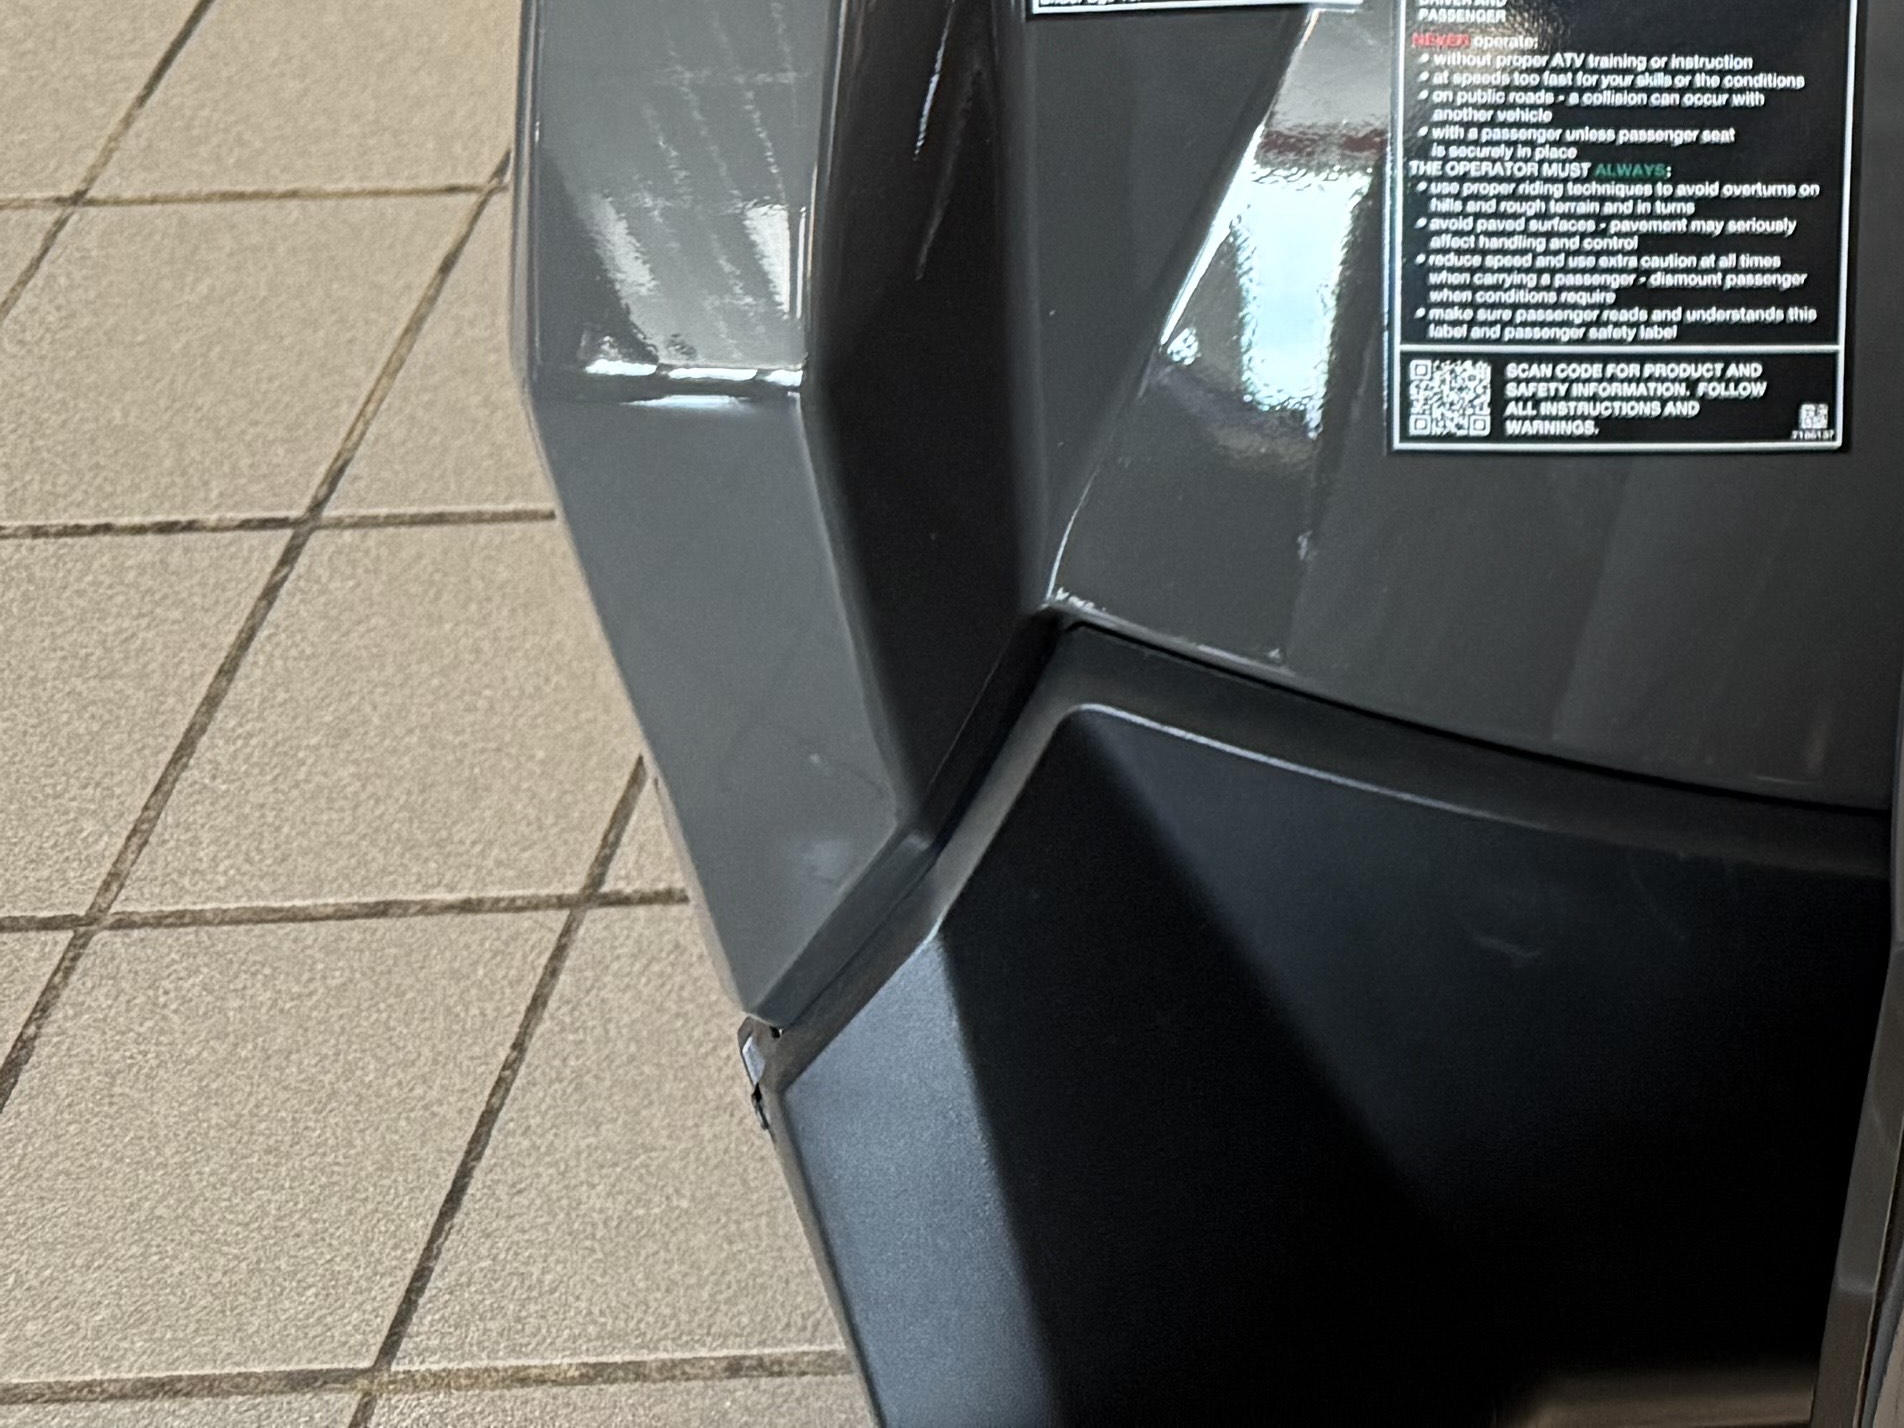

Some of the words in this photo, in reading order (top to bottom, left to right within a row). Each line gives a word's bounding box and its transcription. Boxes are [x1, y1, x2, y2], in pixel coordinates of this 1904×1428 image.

[1505, 362, 1552, 378] SCAN
[1554, 362, 1602, 379] CODE
[1604, 362, 1640, 378] FOR
[1642, 362, 1723, 378] PRODUCT
[1725, 362, 1762, 377] AND
[1505, 381, 1569, 397] SAFETY
[1570, 381, 1690, 397] INFORMATION.
[1696, 381, 1766, 397] FOLLOW
[1504, 400, 1537, 416] ALL
[1539, 400, 1661, 416] INSTRUCTIONS
[1663, 400, 1699, 416] AND
[1505, 419, 1598, 435] WARNINGS.
